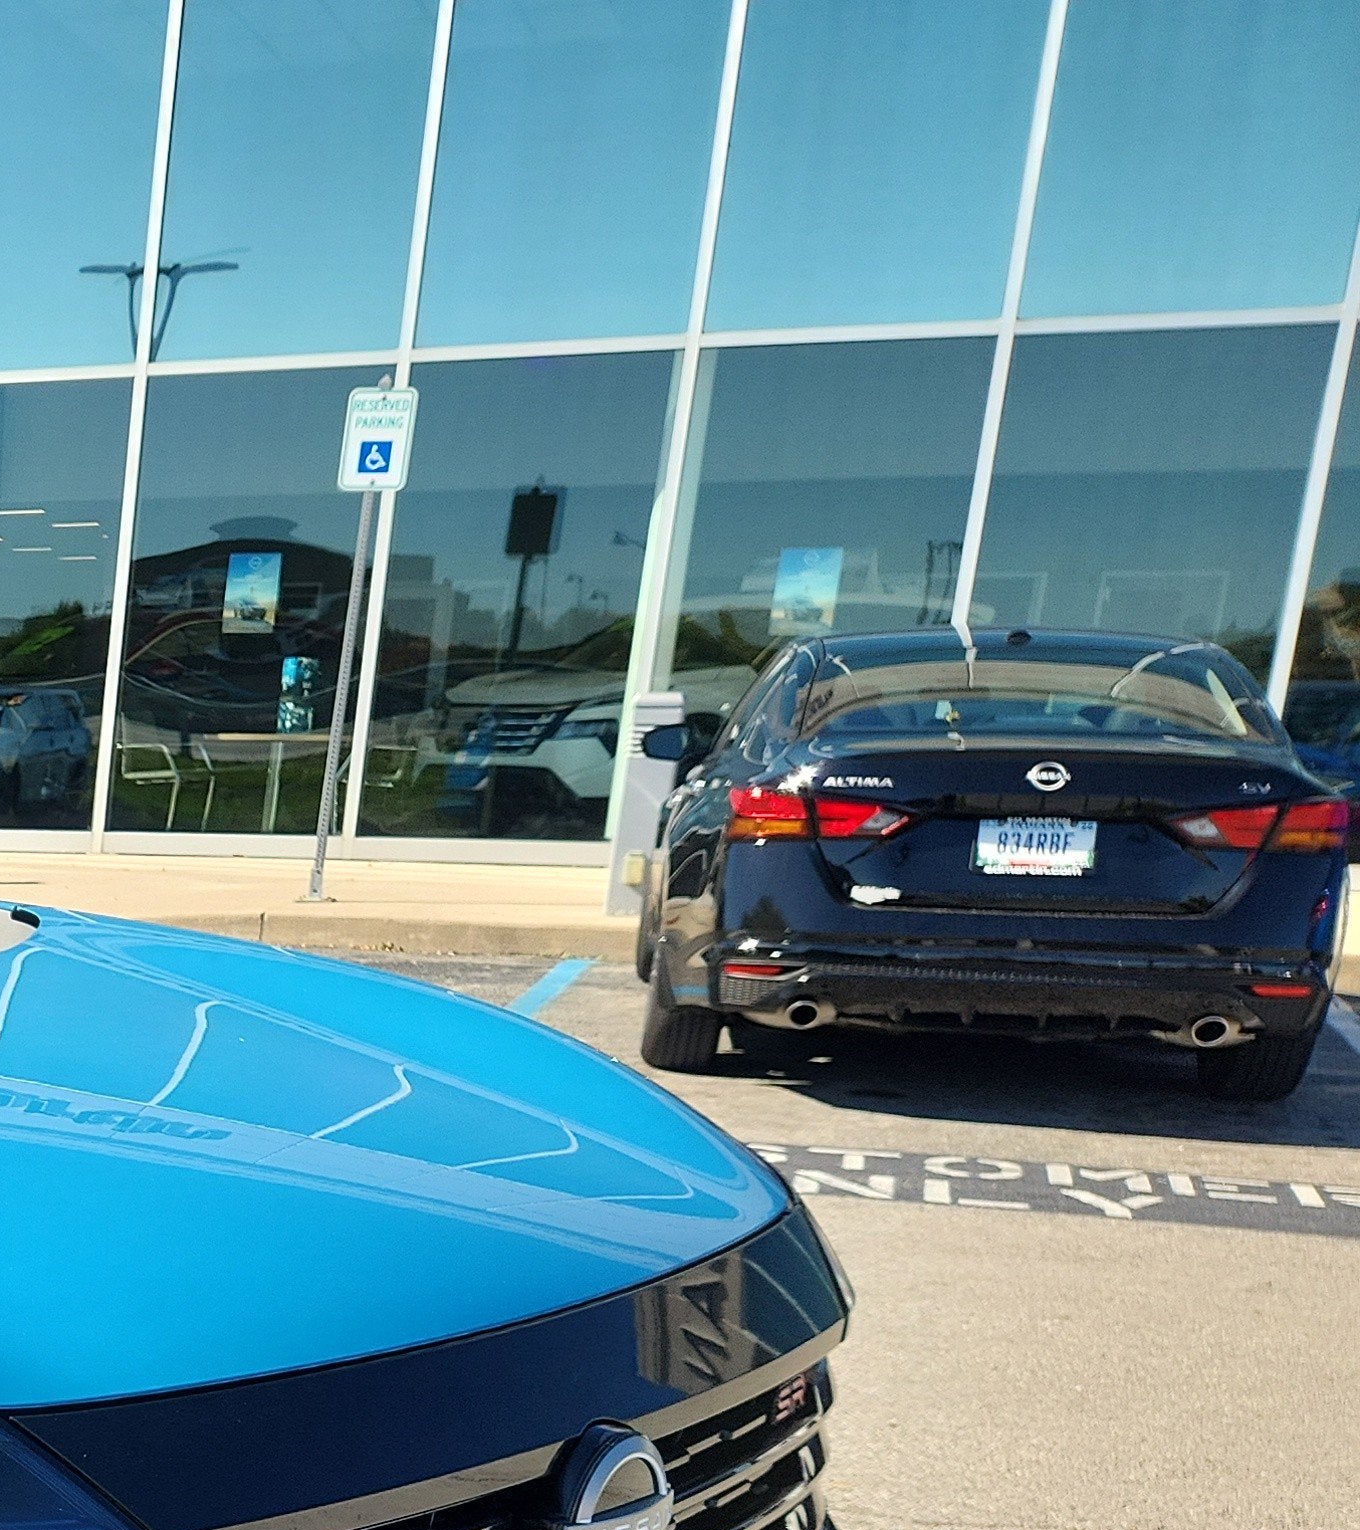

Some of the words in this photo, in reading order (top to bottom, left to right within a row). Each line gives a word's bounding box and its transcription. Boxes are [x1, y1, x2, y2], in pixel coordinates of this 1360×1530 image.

[353, 397, 410, 412] RESERVED
[354, 415, 404, 430] PARKING
[822, 776, 895, 789] ALTIMA
[996, 830, 1075, 855] 834RBF
